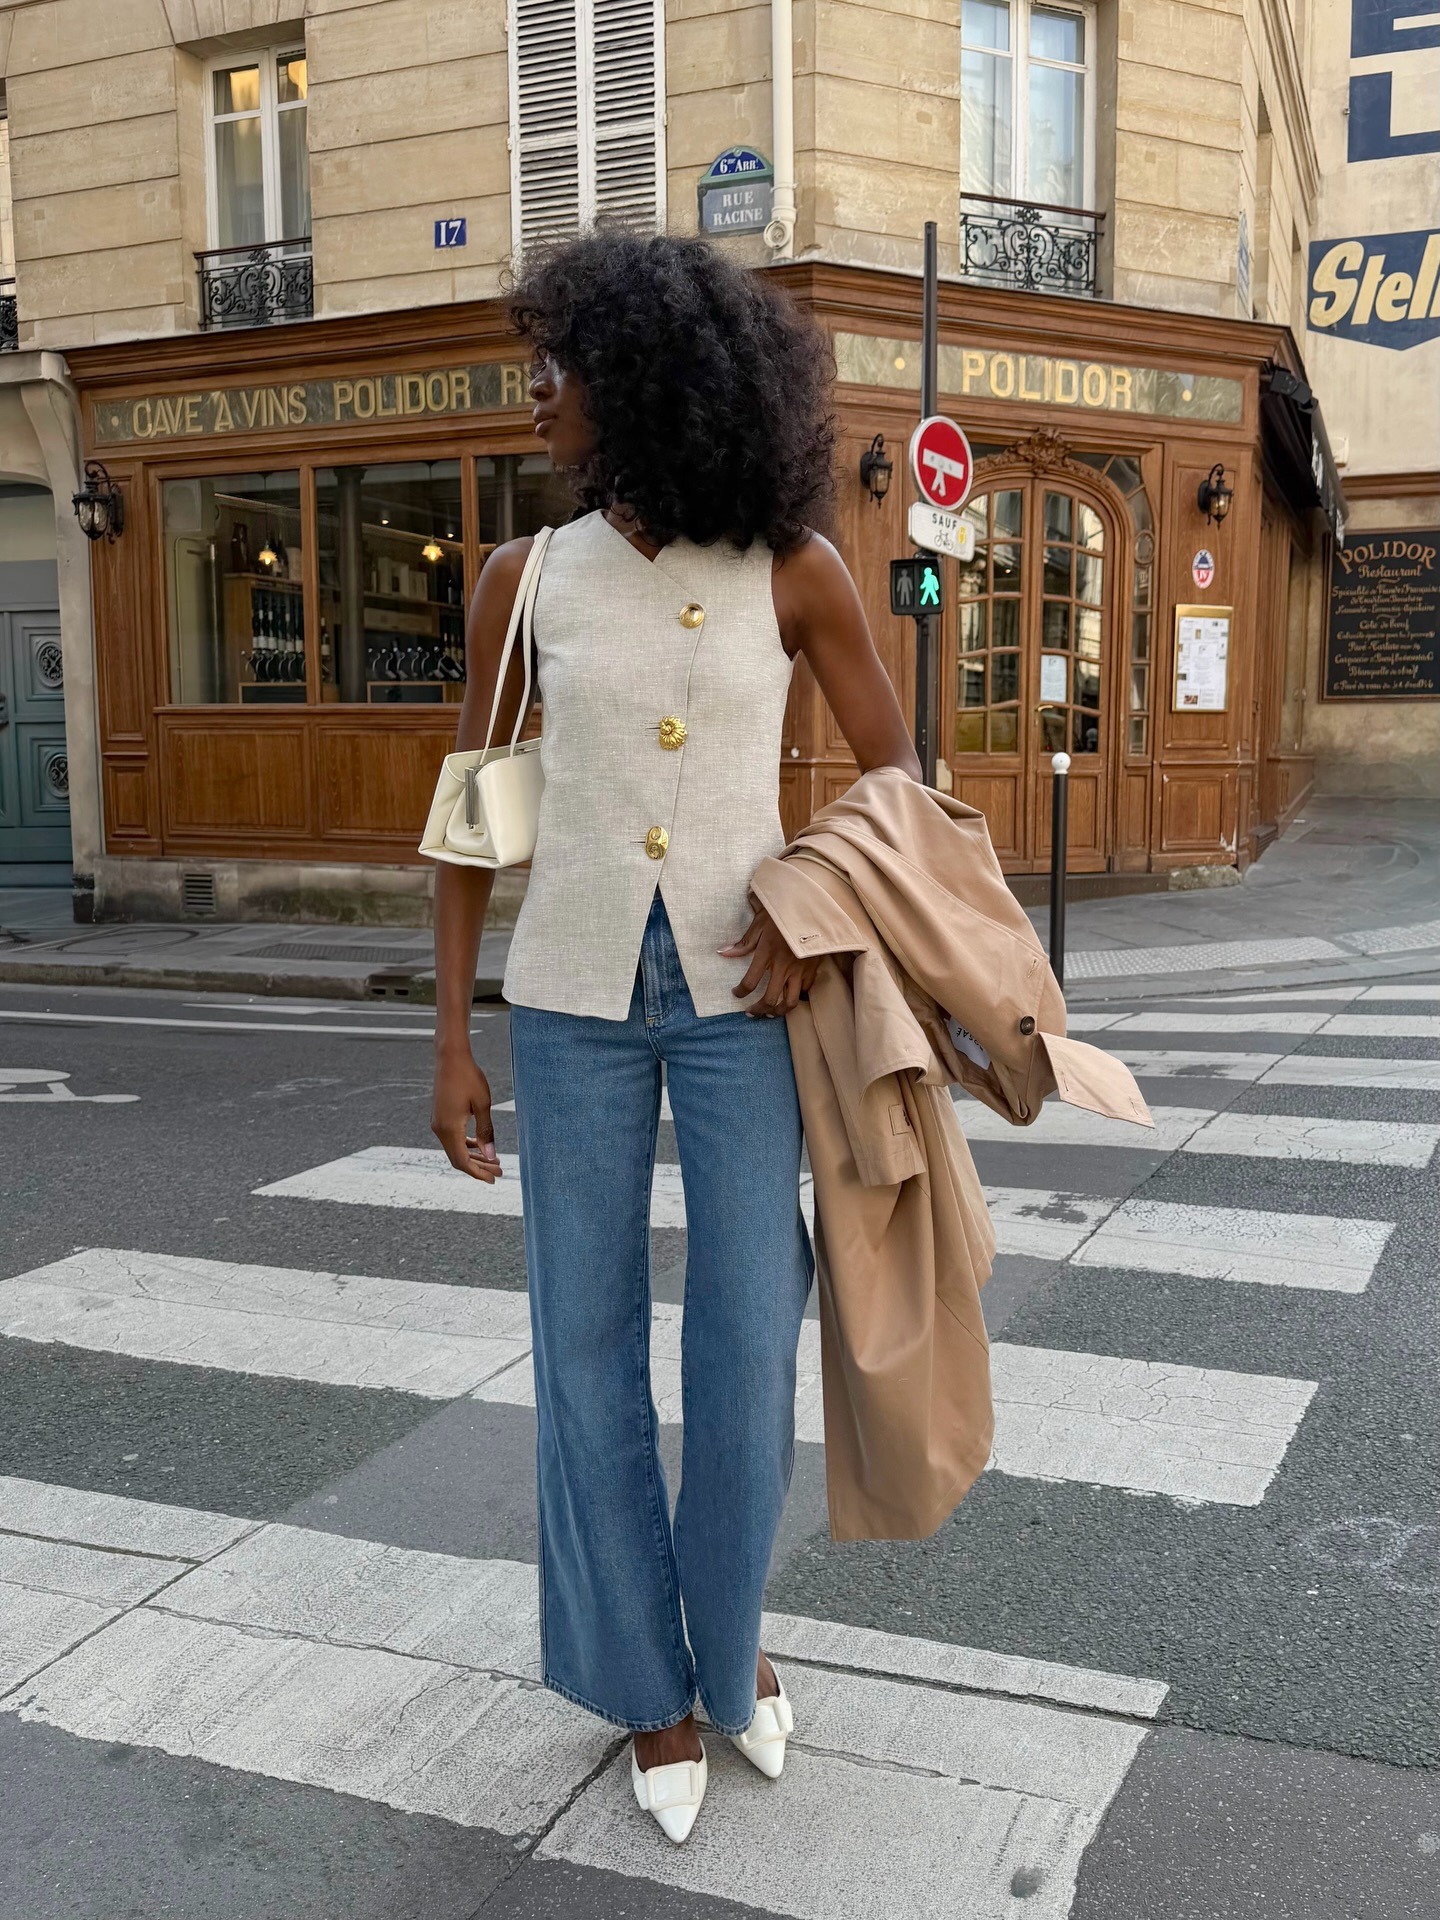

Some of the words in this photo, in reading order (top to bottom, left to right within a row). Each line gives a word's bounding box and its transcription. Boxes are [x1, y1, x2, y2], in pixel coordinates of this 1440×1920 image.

[722, 191, 754, 207] RUE
[713, 207, 763, 226] RACINE
[439, 220, 462, 246] 17
[962, 350, 1133, 410] POLIDOR
[132, 395, 204, 439] CAVE
[239, 385, 307, 429] VINS
[333, 368, 472, 421] POLIDOR
[931, 512, 958, 531] SAUF
[1335, 540, 1437, 575] POLIDOR
[1357, 564, 1423, 579] Restaurant
